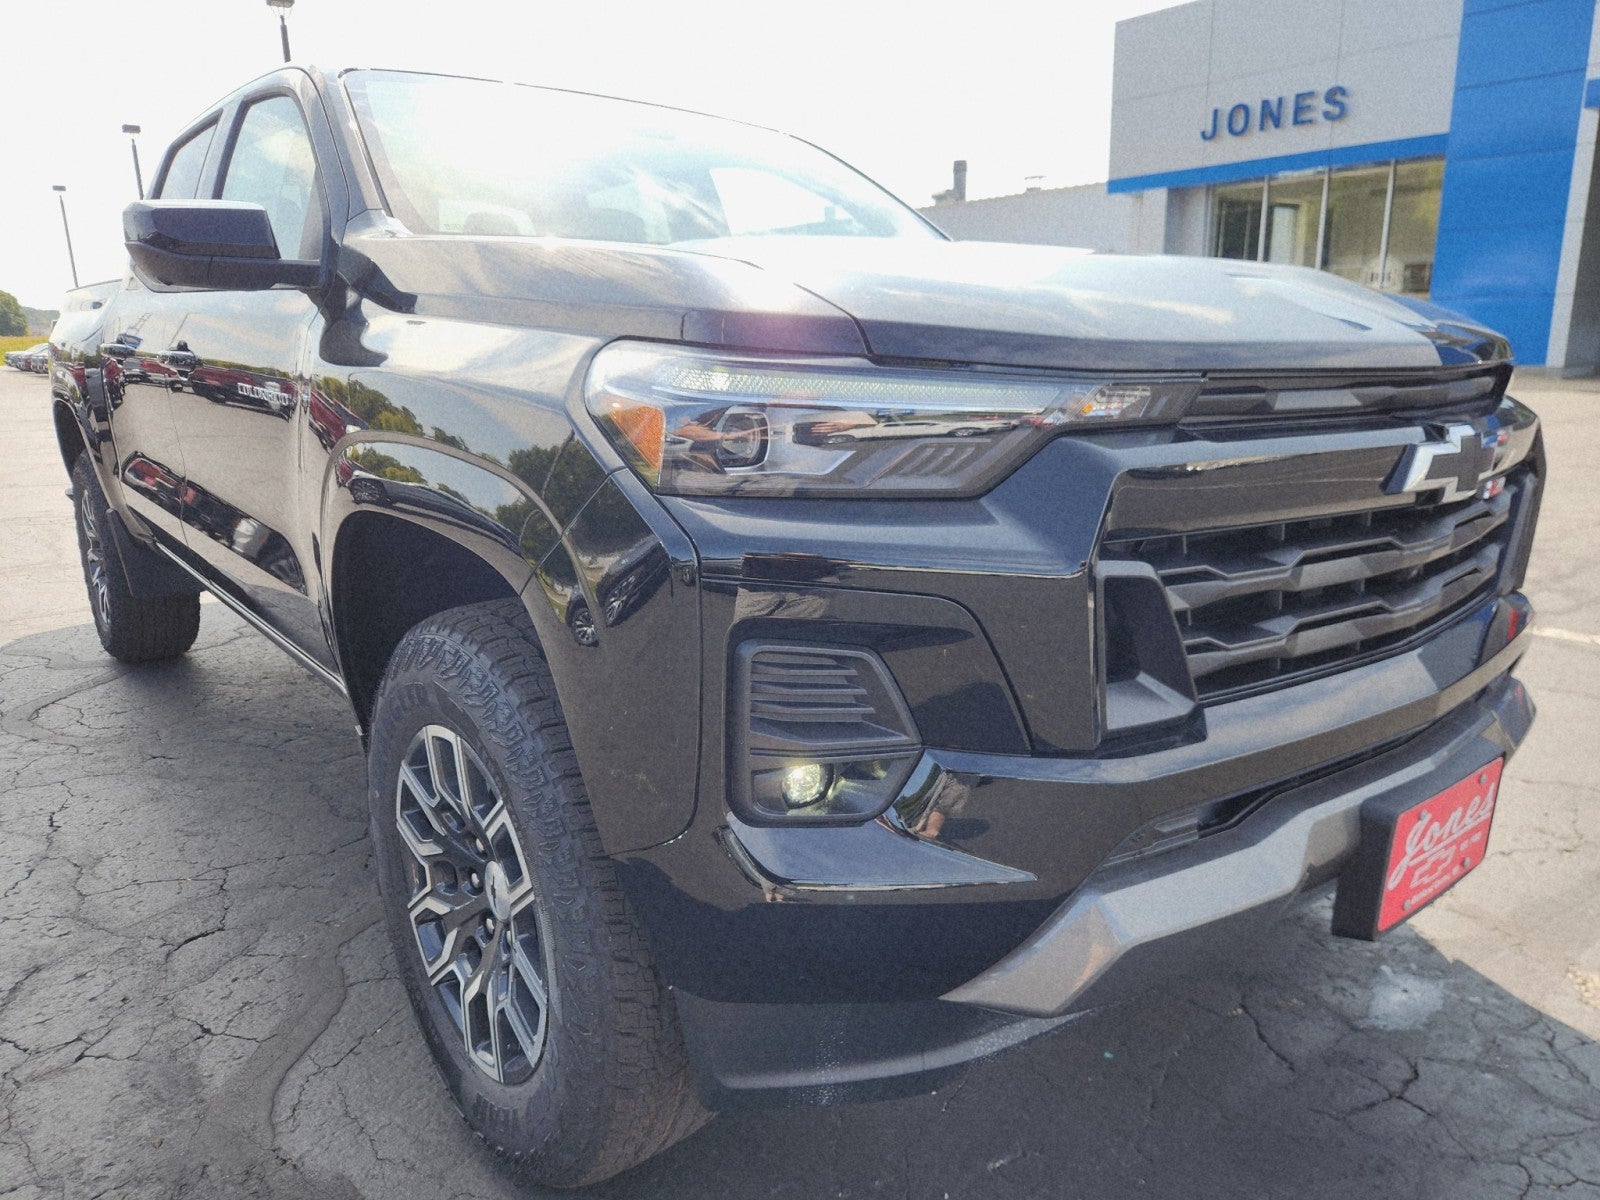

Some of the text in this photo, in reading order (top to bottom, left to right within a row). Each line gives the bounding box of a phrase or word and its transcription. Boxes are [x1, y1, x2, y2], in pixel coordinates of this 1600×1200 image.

[1201, 86, 1347, 141] JONES
[237, 382, 289, 406] COLORADO
[1387, 782, 1496, 890] Jones
